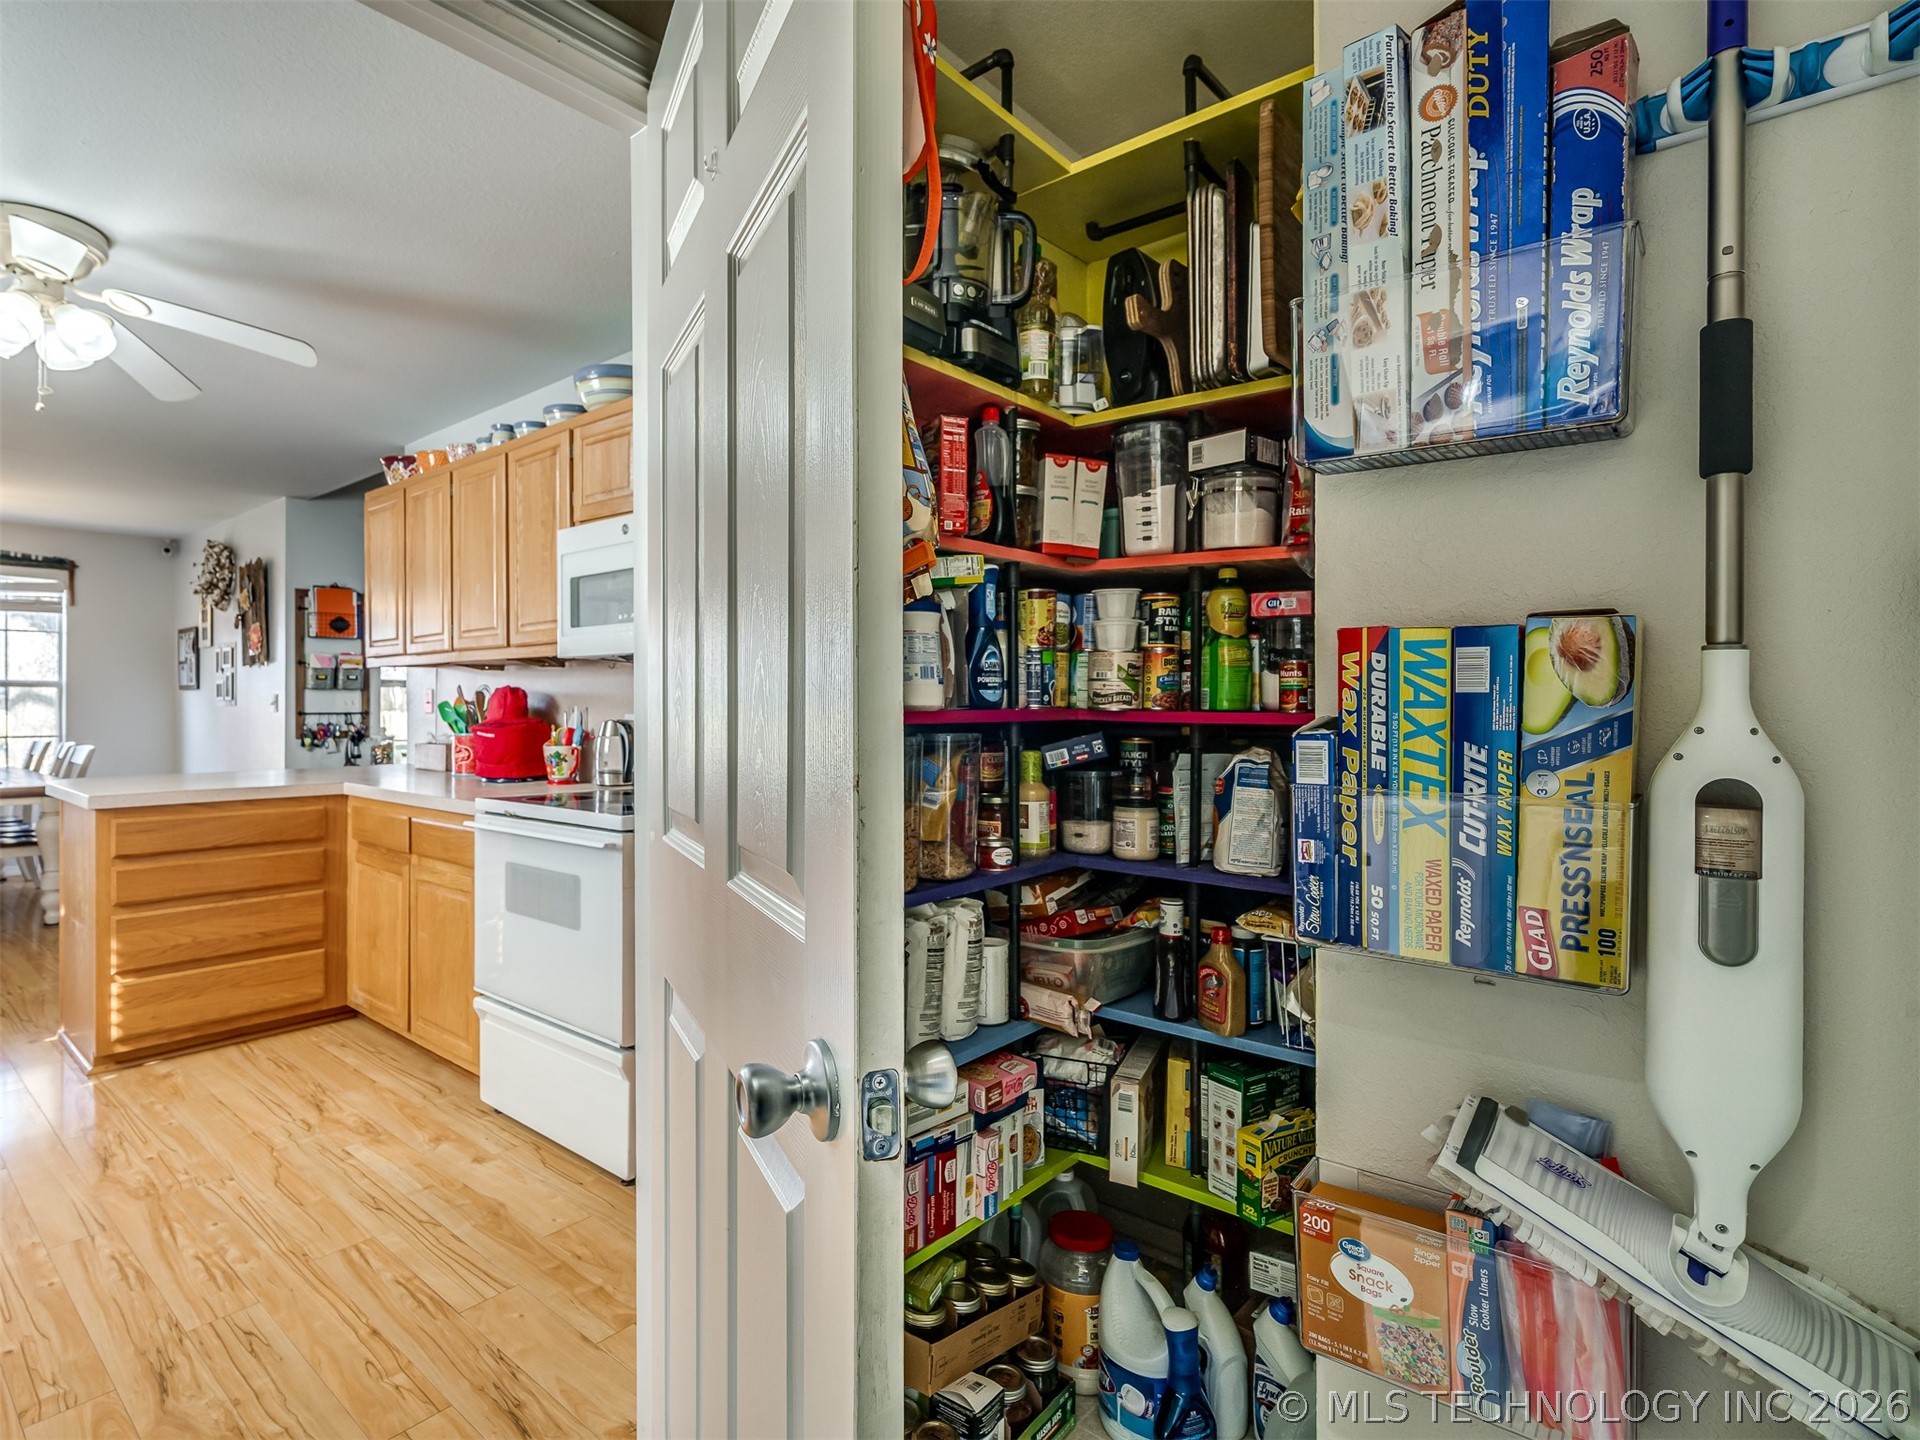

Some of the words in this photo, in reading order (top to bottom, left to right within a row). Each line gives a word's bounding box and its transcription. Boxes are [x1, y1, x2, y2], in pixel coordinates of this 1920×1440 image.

[1386, 35, 1394, 88] Parchment
[1468, 28, 1489, 118] DUTY
[1591, 50, 1603, 76] 250
[1387, 102, 1395, 117] the
[1583, 111, 1591, 133] U.S.A.
[1388, 120, 1396, 150] Secret
[1388, 153, 1395, 162] to
[1388, 166, 1397, 196] Better
[1421, 124, 1443, 232] Parchment
[1388, 199, 1398, 237] Baking!
[1490, 213, 1498, 235] 1947
[1561, 188, 1602, 266] Wrap
[1415, 238, 1437, 290] aper
[1489, 240, 1497, 270] SINCE
[1602, 241, 1610, 259] 1947
[1599, 263, 1608, 288] SINCE
[1488, 274, 1496, 320] TRUSTED
[1597, 290, 1606, 329] TRUSTED
[1557, 270, 1599, 404] Reynolds
[1438, 348, 1450, 366] Roll
[1154, 617, 1180, 625] STYL
[1158, 608, 1180, 616] RANC
[1342, 651, 1359, 737] Wax
[1371, 652, 1386, 771] DURABLE
[1392, 712, 1398, 720] 75
[1392, 721, 1398, 730] SQ
[1403, 639, 1447, 837] WAXTEX
[1497, 749, 1513, 812] PAPER
[1338, 747, 1359, 866] Paper
[1459, 742, 1488, 856] CUT-RITE
[1392, 832, 1397, 844] mm
[1496, 814, 1513, 857] WAX
[1305, 874, 1320, 906] Cooker
[1404, 881, 1412, 897] AND
[1415, 872, 1423, 886] FOR
[1425, 859, 1442, 906] WAXED
[1371, 885, 1383, 909] 50
[1404, 898, 1412, 924] BAKING
[1415, 887, 1423, 908] YOUR
[1306, 906, 1320, 934] Slow
[1371, 911, 1379, 940] SQ.FT.
[1455, 876, 1475, 947] Reynolds
[1404, 925, 1413, 948] NEEDS
[1414, 908, 1424, 950] MICROWAVE
[1425, 909, 1442, 952] PAPER
[1523, 909, 1553, 971] GLAD
[1597, 928, 1616, 957] 100
[1263, 1135, 1298, 1162] NATURE
[1278, 1145, 1312, 1165] CRUNCHY
[986, 1162, 998, 1192] Dolly
[1536, 1157, 1592, 1189] Swiffer
[906, 1196, 917, 1226] Dolly
[1303, 1213, 1330, 1232] 200
[1303, 1228, 1316, 1236] BAGS
[1342, 1241, 1364, 1253] Great
[1347, 1248, 1365, 1258] Value
[1414, 1247, 1440, 1261] Single
[1356, 1263, 1385, 1278] Square
[1413, 1255, 1441, 1268] Zipper
[1454, 1265, 1464, 1274] 4
[1348, 1268, 1394, 1294] Snack
[1360, 1285, 1382, 1299] Bags
[1479, 1268, 1489, 1297] Liners
[1468, 1304, 1479, 1327] Slow
[1478, 1299, 1491, 1331] Cooker
[1318, 1335, 1330, 1344] BAGS
[1463, 1328, 1486, 1395] Boulder
